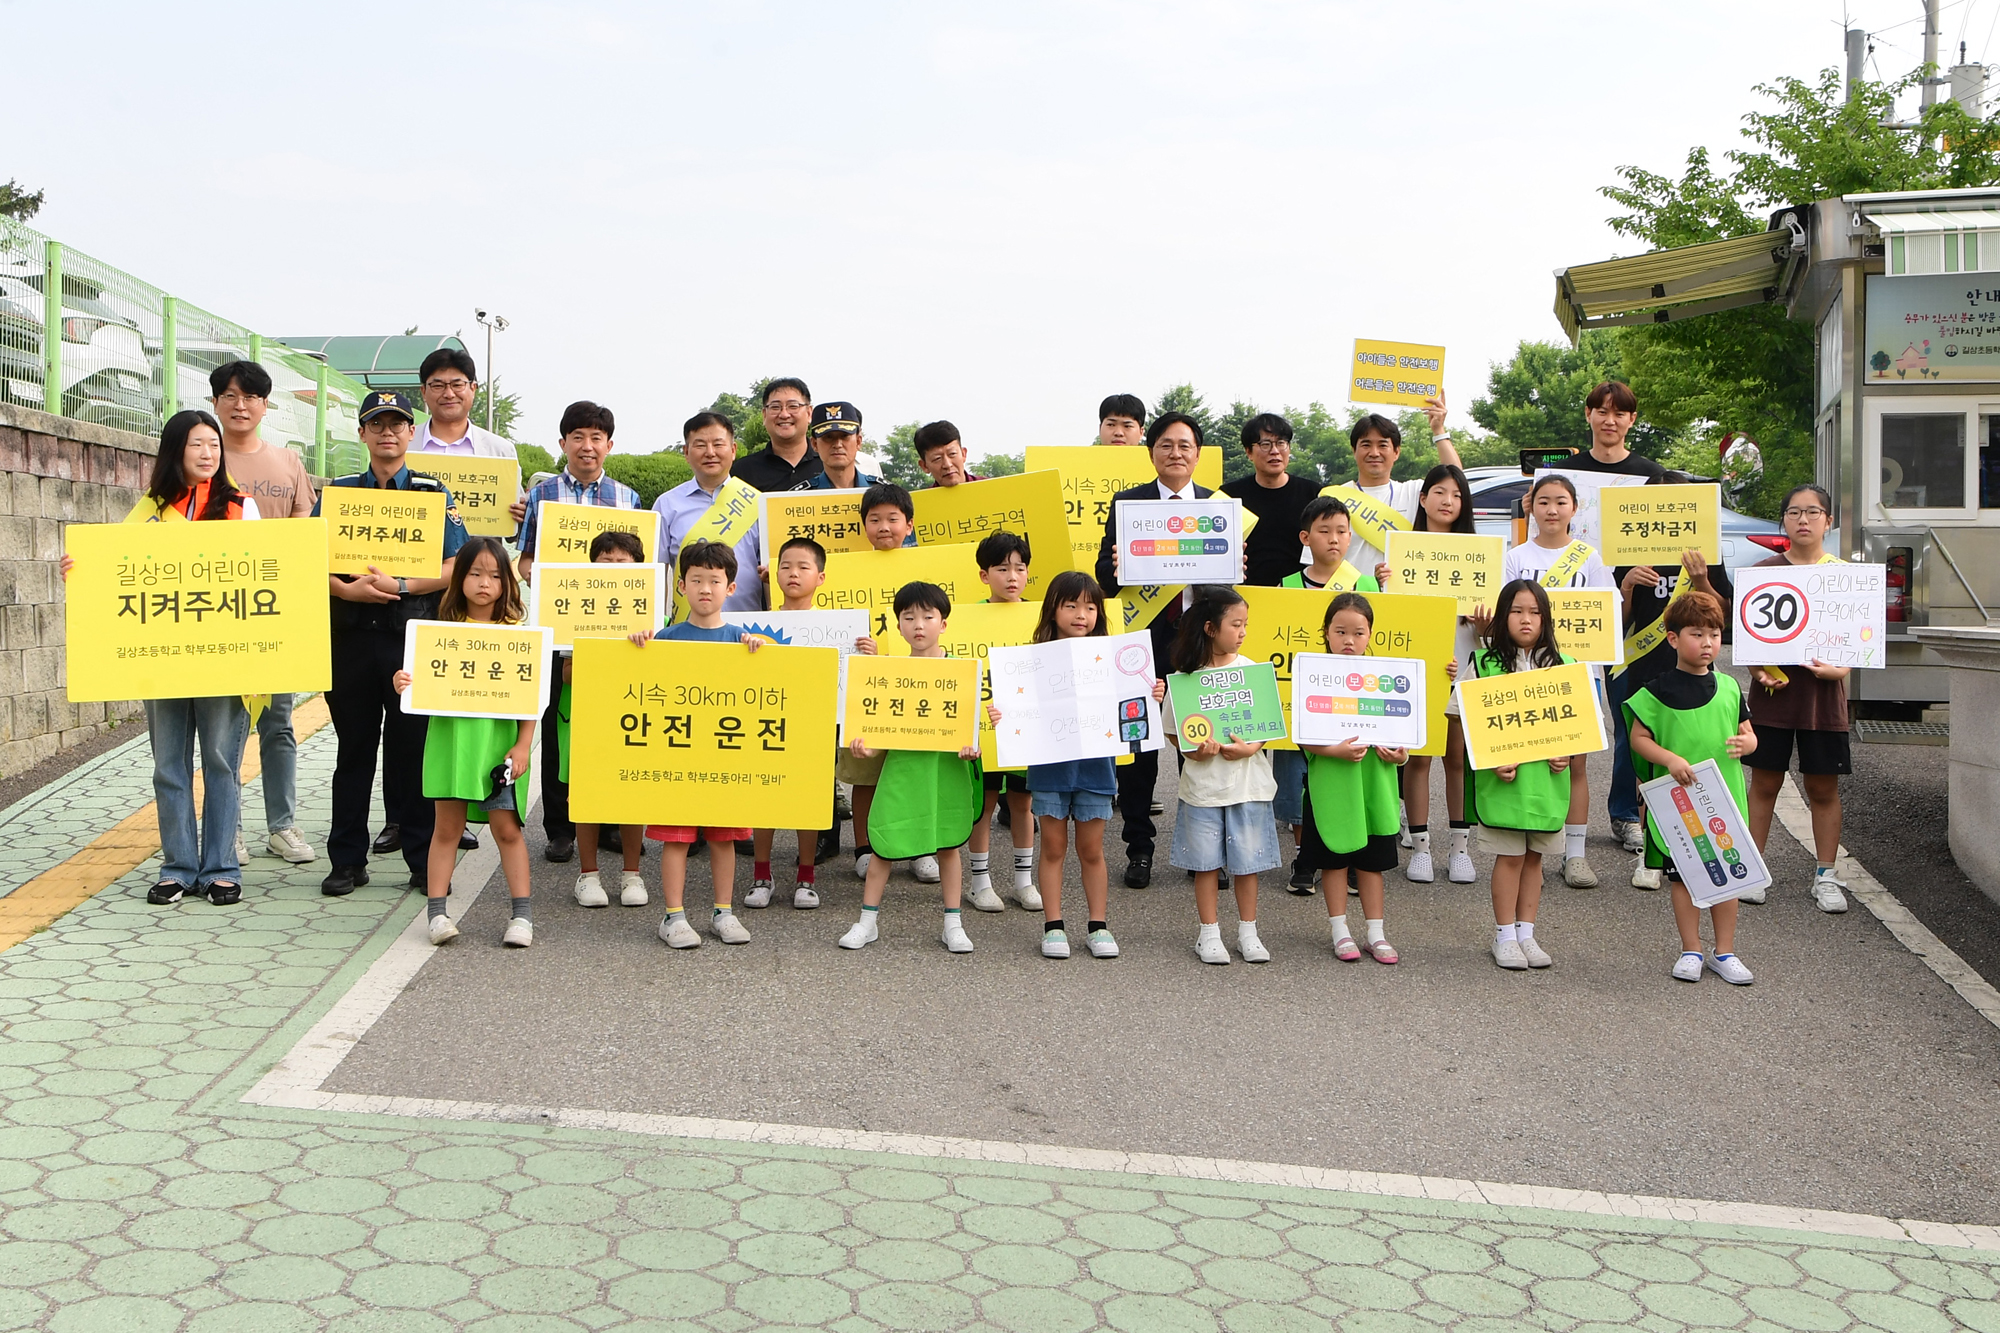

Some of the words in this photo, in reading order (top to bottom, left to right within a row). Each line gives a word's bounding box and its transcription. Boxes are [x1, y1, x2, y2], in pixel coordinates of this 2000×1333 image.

[1904, 313, 1929, 324] 용무가
[1932, 313, 1957, 324] 있으신
[1960, 312, 1976, 323] 분은
[1979, 312, 1996, 323] 방문
[1357, 352, 1397, 367] 아이들은
[1399, 356, 1439, 371] 안전보행
[1354, 377, 1394, 392] 어른들은
[1397, 381, 1437, 396] 안전운행
[457, 473, 498, 485] 보호구역
[1063, 477, 1095, 495] 시속
[253, 480, 295, 499] Klein
[452, 490, 496, 507] 차금지
[339, 503, 374, 517] 길상의
[380, 506, 428, 520] 어린이를
[785, 505, 815, 518] 어린이
[820, 503, 861, 516] 보호구역
[1619, 503, 1650, 514] 어린이
[1655, 502, 1697, 514] 보호구역
[338, 524, 425, 543] 지켜주세요
[558, 518, 590, 532] 길상의
[787, 522, 861, 541] 주정차금지
[917, 520, 952, 542] 린이
[957, 508, 1026, 537] 보호구역
[1620, 521, 1697, 538] 주정차금지
[334, 552, 369, 561] 길상초등학교
[371, 555, 406, 563] 학부모동아리
[1405, 550, 1425, 562] 시속
[1431, 551, 1459, 562] 30km
[1465, 553, 1486, 564] 이하
[116, 561, 182, 586] 길상의
[191, 558, 281, 583] 어린이를
[558, 579, 580, 590] 시속
[586, 579, 617, 589] 30km
[624, 579, 646, 590] 이하
[117, 588, 281, 624] 지켜주세요
[817, 588, 873, 610] 어린이
[1562, 600, 1602, 611] 보호구역
[1751, 592, 1798, 631] 30
[1813, 600, 1871, 623] 구역에선
[1557, 618, 1602, 634] 차금지
[435, 638, 459, 651] 시속
[466, 640, 500, 652] 30km
[507, 641, 532, 655] 이하
[1272, 626, 1310, 647] 시속
[1375, 630, 1412, 652] 이하
[116, 645, 181, 658] 길상초등학교
[185, 642, 249, 655] 학부모동아리
[865, 676, 889, 689] 시속
[895, 678, 928, 689] 30km
[934, 679, 958, 691] 이하
[1200, 669, 1245, 689] 어린이
[623, 682, 668, 707] 시속
[674, 685, 736, 707] 30km
[744, 687, 788, 711] 이하
[1199, 689, 1253, 711] 보호구역
[1481, 690, 1518, 708] 길상의
[1524, 681, 1573, 701] 어린이를
[1219, 710, 1252, 722] 속도를
[1487, 704, 1578, 732] 지켜주세요
[1187, 723, 1207, 738] 30
[1490, 738, 1525, 753] 길상초등학교
[1527, 735, 1563, 747] 학부모동아리
[619, 769, 684, 782] 길상초등학교
[687, 771, 752, 785] 학부모동아리
[756, 773, 786, 786] "일비"
